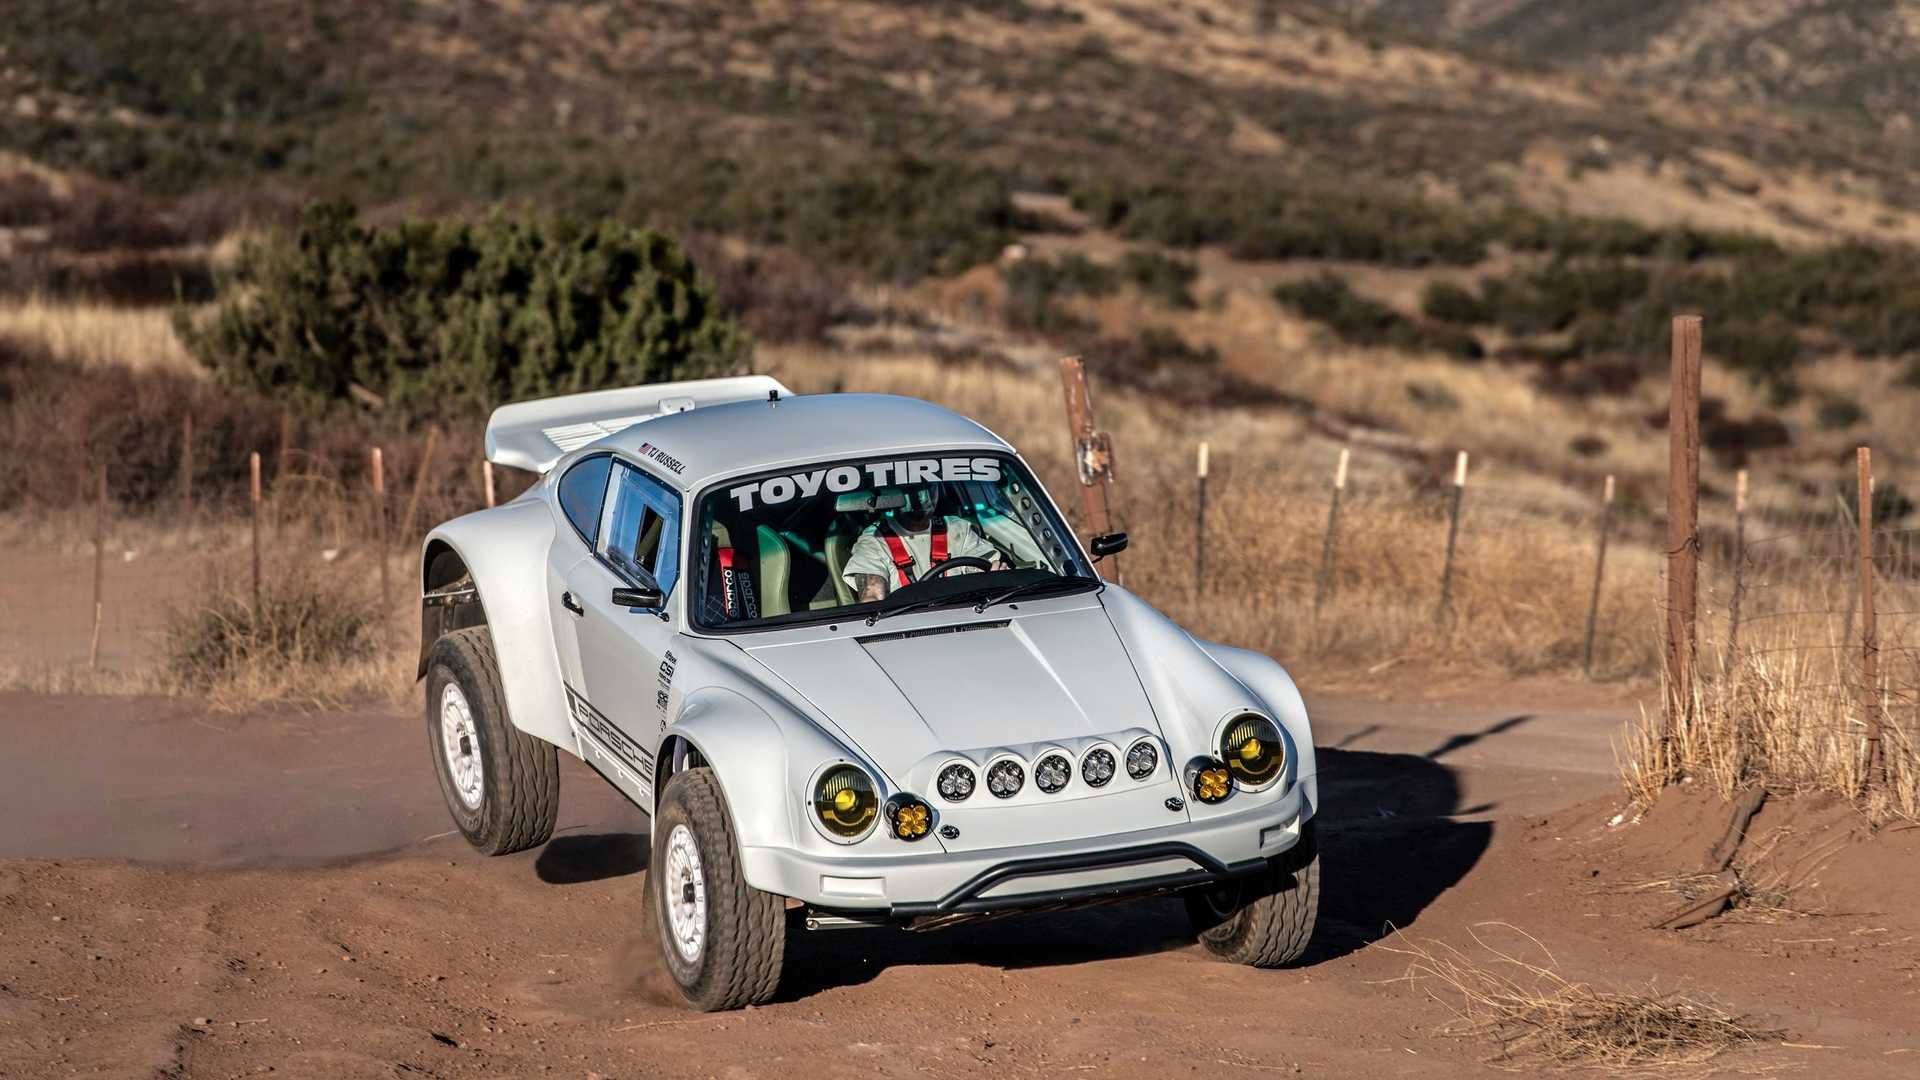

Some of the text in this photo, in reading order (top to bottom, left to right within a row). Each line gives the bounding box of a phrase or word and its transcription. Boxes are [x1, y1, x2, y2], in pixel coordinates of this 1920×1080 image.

[647, 447, 686, 475] TJ RUSSELL
[730, 458, 1001, 512] TOYO TIRES
[740, 572, 758, 618] sparco
[578, 703, 654, 775] PORSCHE
